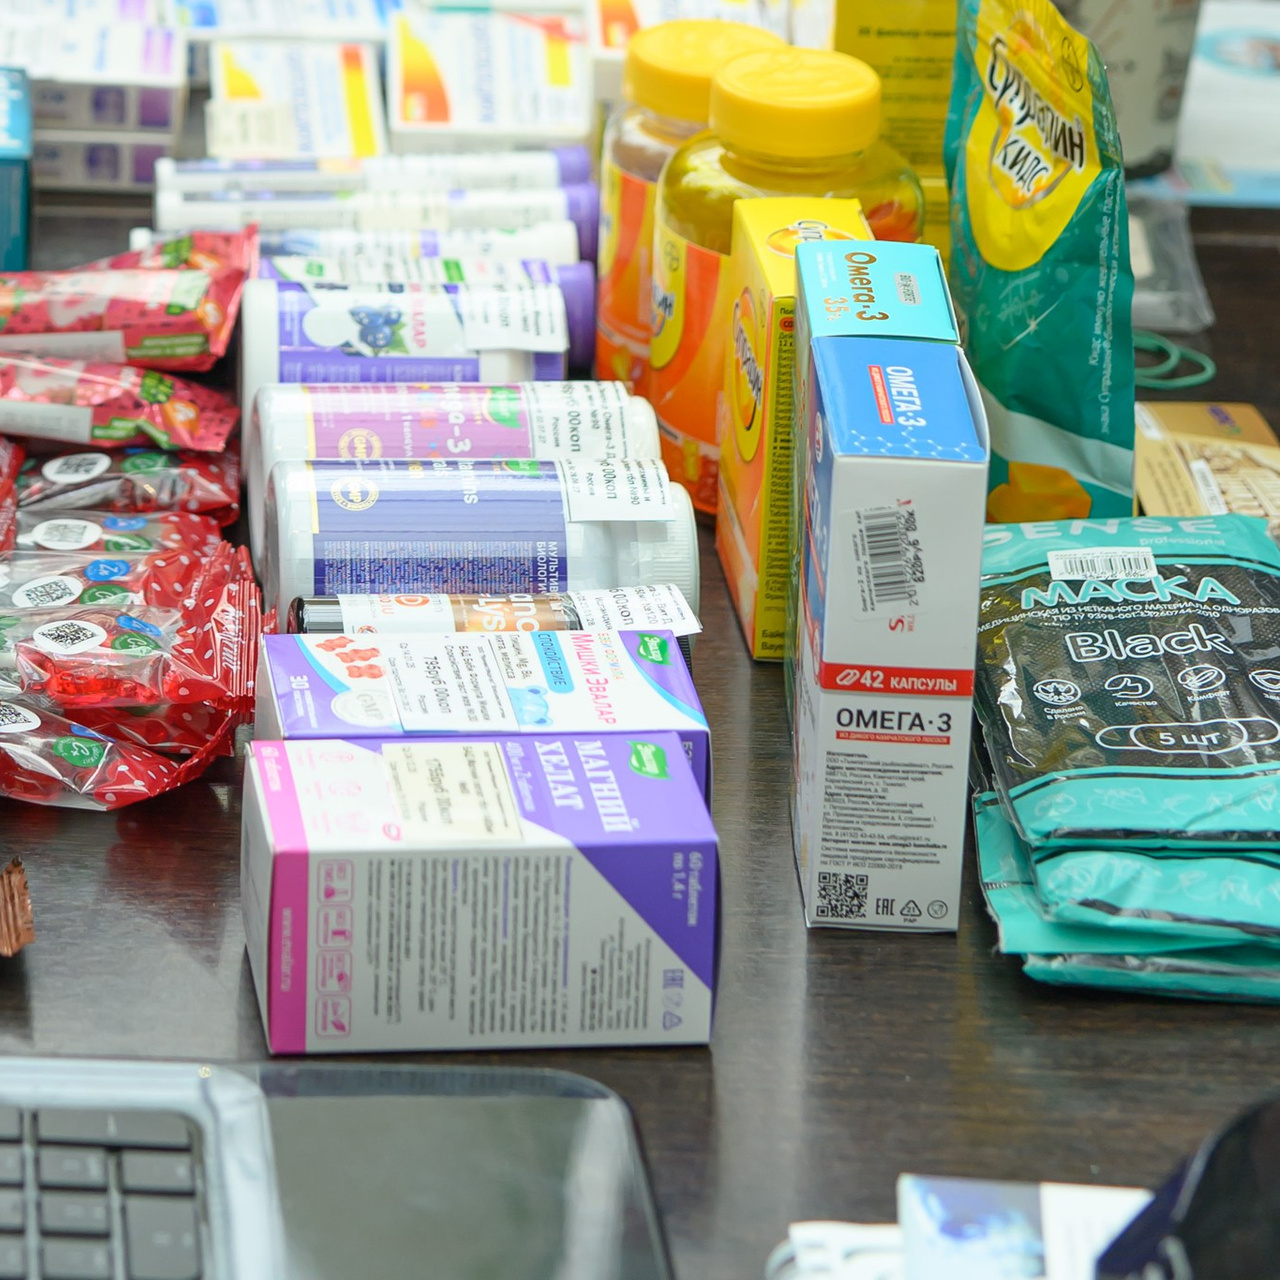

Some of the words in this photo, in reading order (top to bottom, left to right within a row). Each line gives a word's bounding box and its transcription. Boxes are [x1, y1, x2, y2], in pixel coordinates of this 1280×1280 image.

[569, 410, 582, 454] 00коп
[1021, 576, 1241, 610] МАСКА
[1061, 606, 1075, 615] ИЗ
[1076, 604, 1141, 614] НЕТКАНОГО
[1144, 602, 1210, 611] МАТЕРИАЛА
[1065, 623, 1234, 662] Black
[537, 633, 568, 686] СПОКОЙСТВИЕ
[290, 675, 310, 690] 30
[860, 670, 884, 688] 42
[890, 677, 957, 691] КАПСУЛЫ
[1114, 699, 1158, 708] Качество
[1187, 690, 1231, 703] Комфорт
[1043, 704, 1084, 715] Сделано
[1053, 709, 1086, 720] России
[1160, 732, 1174, 745] 5
[534, 741, 584, 810] ХЕЛАТ
